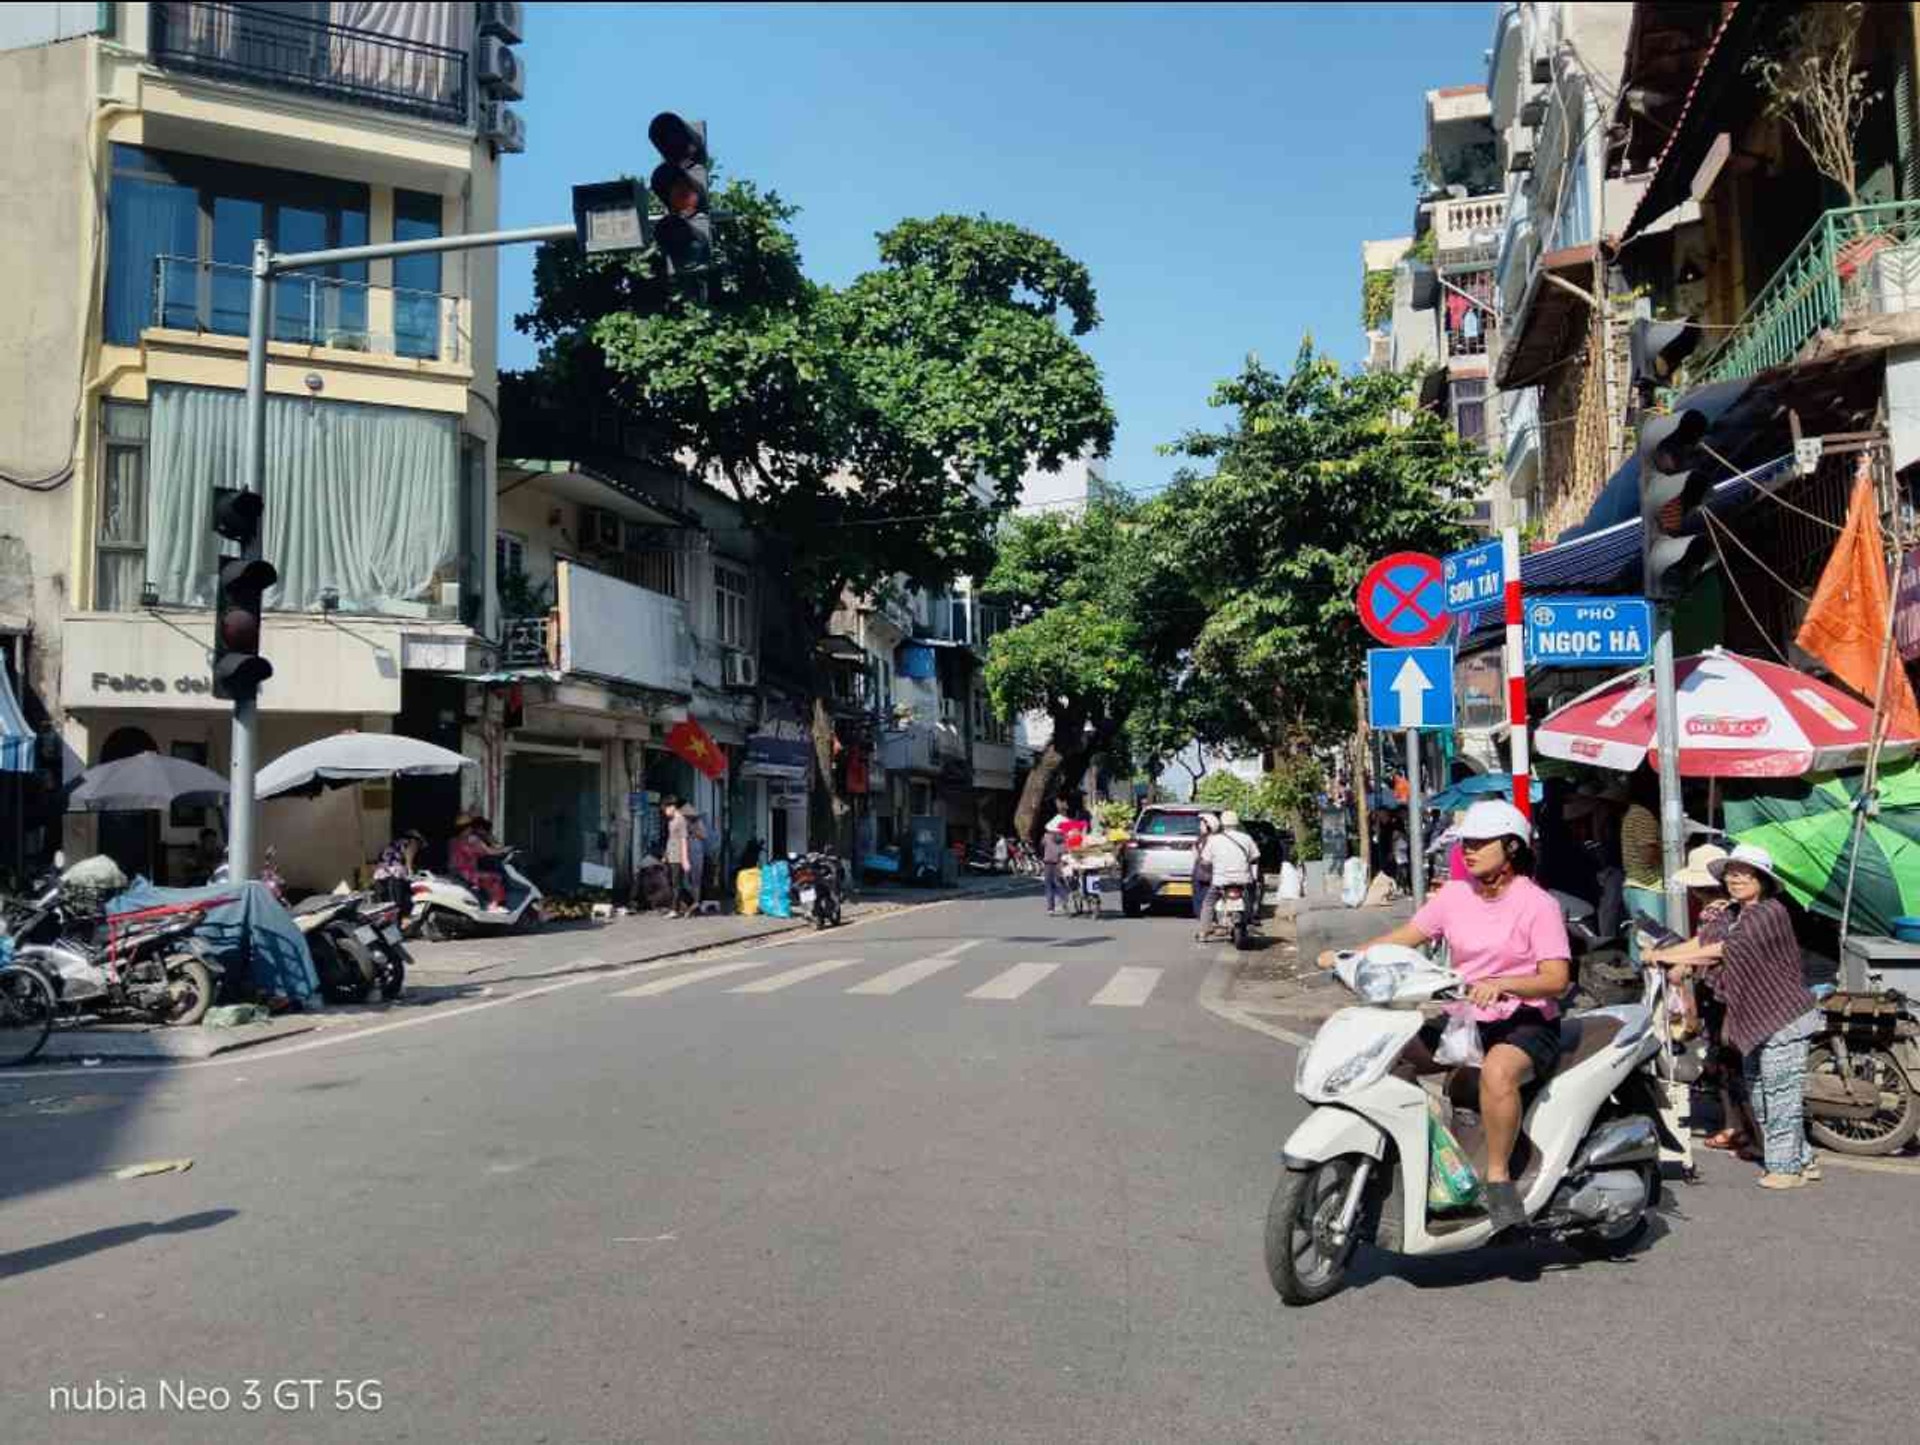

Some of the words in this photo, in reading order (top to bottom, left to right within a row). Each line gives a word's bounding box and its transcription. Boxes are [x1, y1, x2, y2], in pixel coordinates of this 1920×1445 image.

[1577, 602, 1616, 620] PHỐ
[1539, 630, 1602, 658] NGỌC
[1609, 625, 1641, 652] HÀ
[91, 672, 166, 693] Felice
